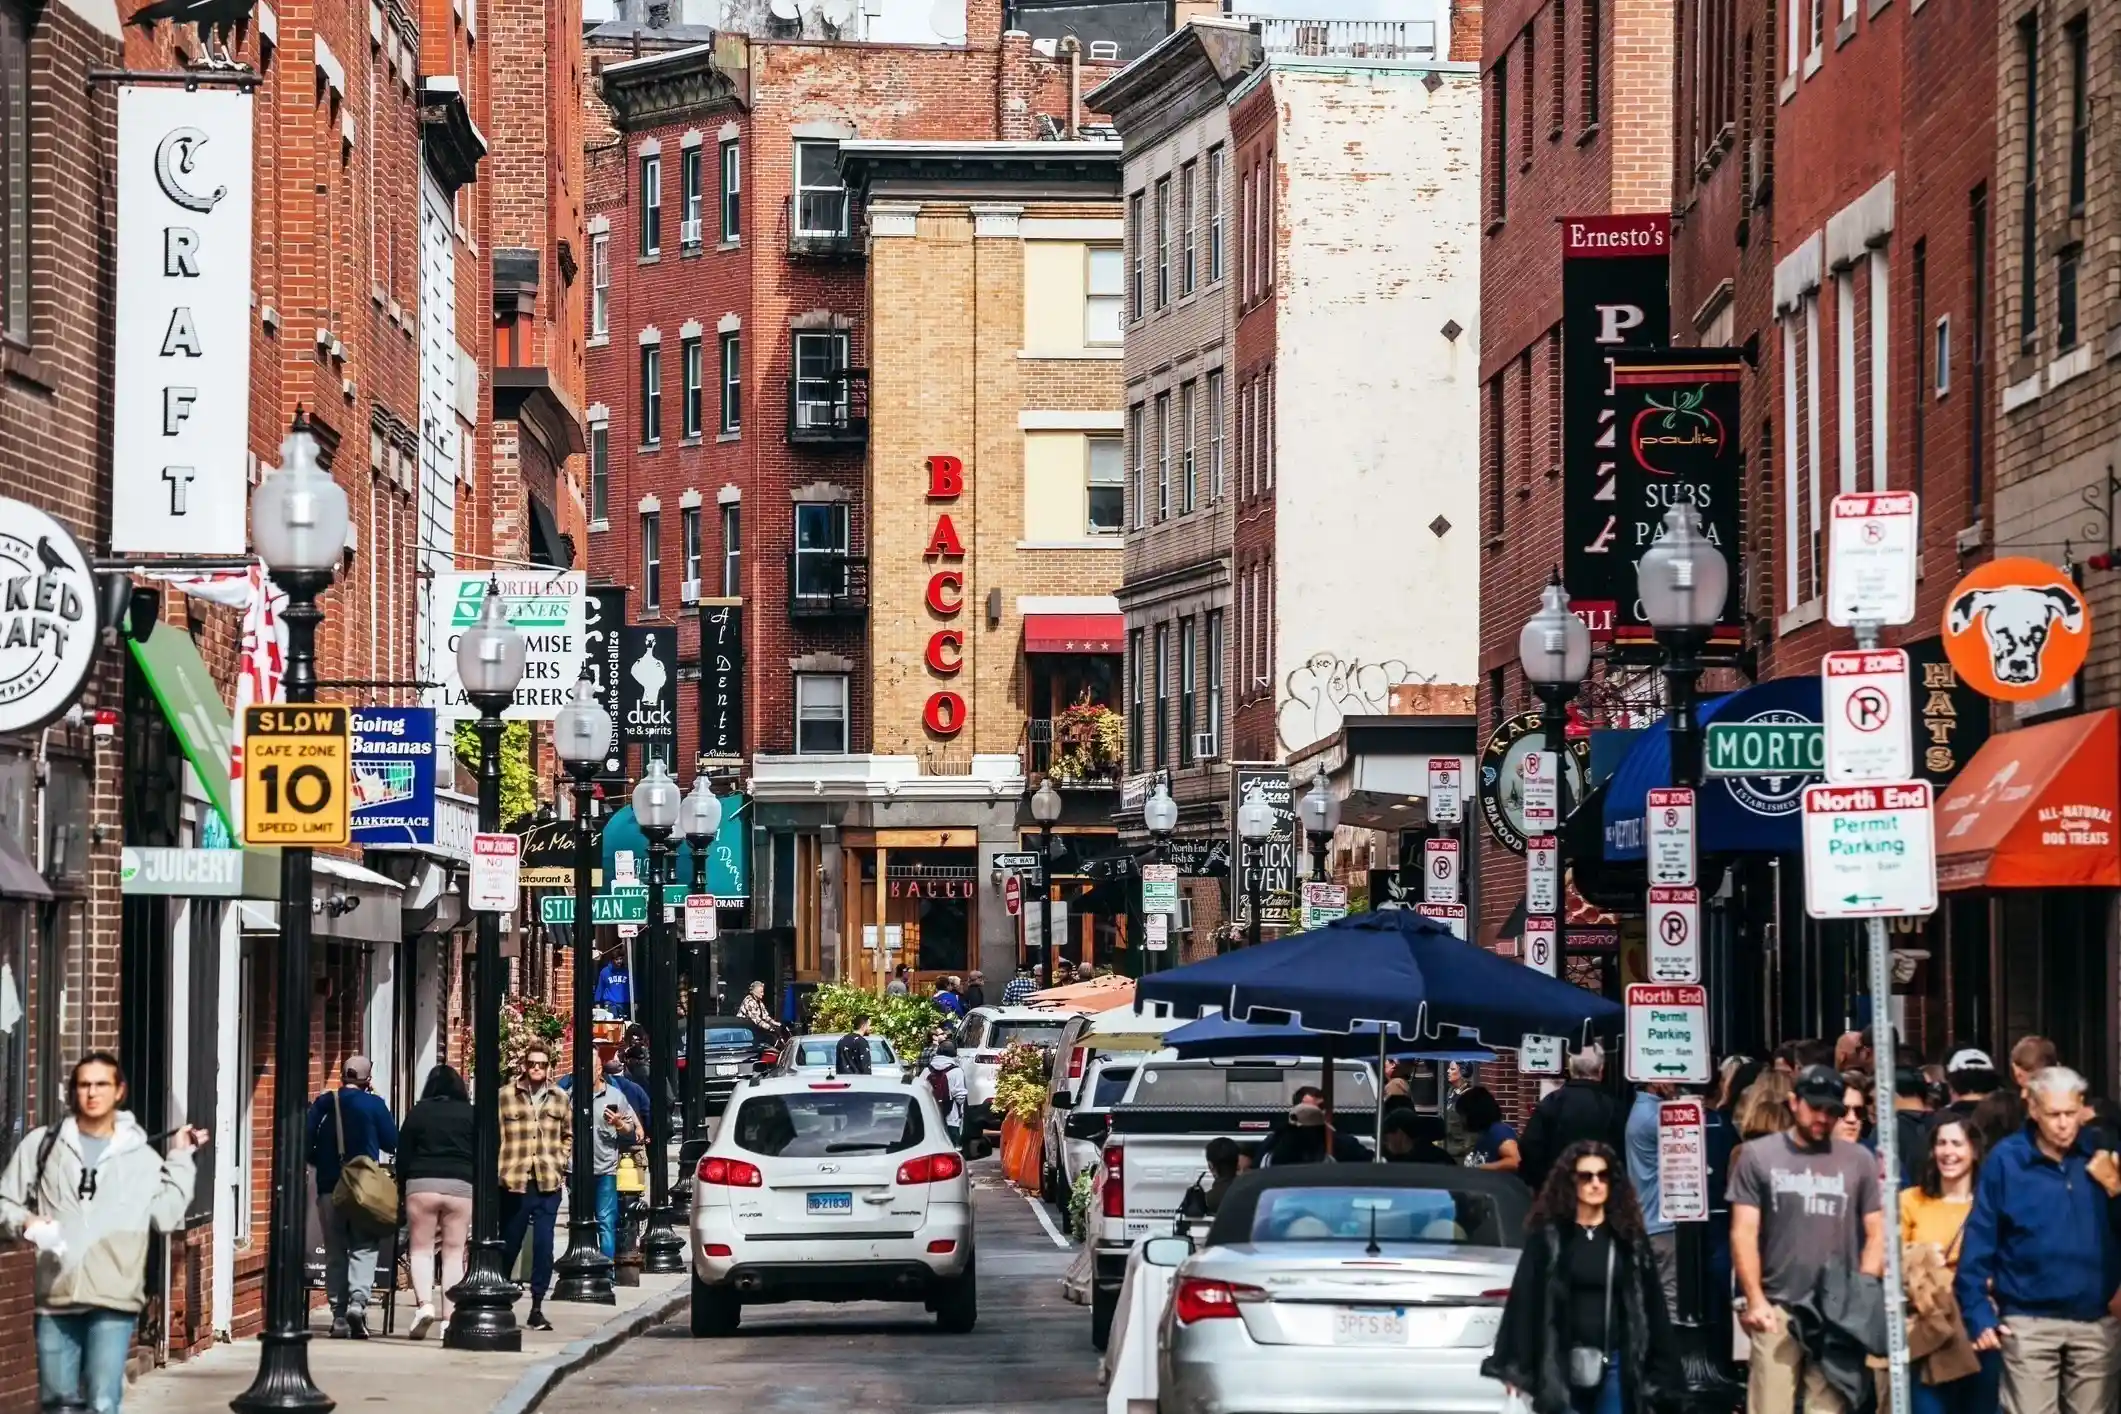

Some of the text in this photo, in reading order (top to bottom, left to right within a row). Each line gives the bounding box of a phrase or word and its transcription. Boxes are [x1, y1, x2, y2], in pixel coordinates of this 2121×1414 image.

[1570, 223, 1664, 248] Ernesto's
[153, 126, 228, 517] CRAFT
[1639, 426, 1719, 447] pauli's
[1635, 522, 1722, 546] PAA
[493, 581, 541, 595] ORTH
[924, 456, 967, 734] BACCO
[0, 575, 84, 622] KED
[0, 616, 69, 661] AFT
[1829, 655, 1904, 674] TOW ZONE
[627, 700, 671, 724] duck
[1922, 663, 1957, 772] HATS
[259, 711, 334, 732] SLOW
[350, 713, 405, 735] Going
[646, 726, 672, 739] spirits
[255, 745, 336, 757] CAFE ZONE
[350, 736, 432, 755] Bananas
[259, 765, 332, 814] 10
[1736, 787, 1797, 811] ESTABLISHED
[1812, 788, 1925, 812] North End
[2038, 804, 2112, 823] ALL-NATURAL
[258, 823, 334, 833] SPEED LIMIT
[1483, 796, 1524, 851] SEAFOOD
[1833, 816, 1899, 833] Permit
[1171, 840, 1208, 852] North End
[1829, 838, 1905, 856] Parking
[2042, 832, 2109, 845] DOG TREATS
[475, 841, 516, 854] TOW ZONE
[486, 858, 503, 867] NO
[1004, 857, 1018, 865] ONE
[1171, 852, 1197, 863] Fish &
[563, 875, 572, 883] &
[1651, 889, 1697, 902] TOW ZONE
[632, 908, 642, 917] ST
[1262, 909, 1290, 919] IZZA
[1420, 907, 1464, 918] North End
[1633, 989, 1702, 1004] North End
[1650, 1010, 1688, 1023] Permit
[1648, 1028, 1691, 1042] Parking
[1674, 1108, 1697, 1122] ZONE
